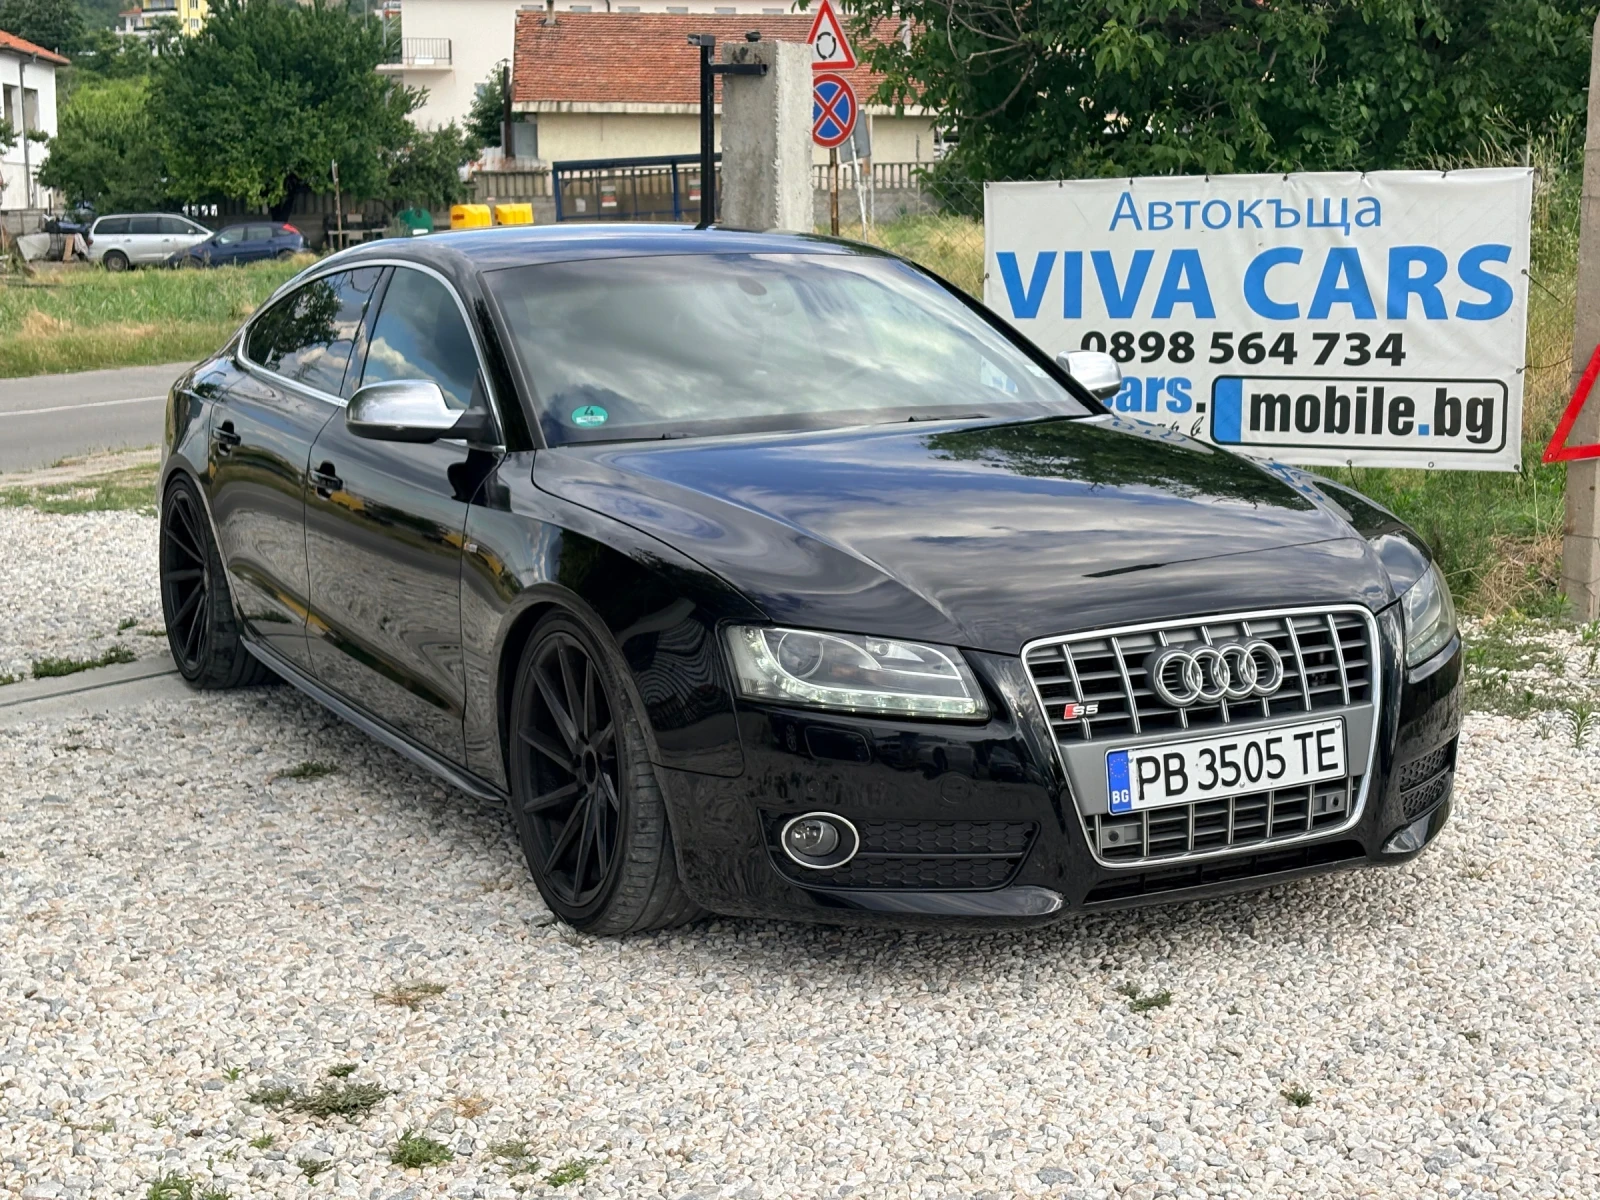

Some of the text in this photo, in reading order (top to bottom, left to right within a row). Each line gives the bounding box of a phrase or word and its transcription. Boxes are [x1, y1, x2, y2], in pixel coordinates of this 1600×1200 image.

[1109, 191, 1382, 236] Автокъща
[996, 243, 1514, 321] VIVA CARS
[1081, 330, 1406, 366] 0898 564 734
[1102, 376, 1206, 414] ars.
[1250, 386, 1494, 444] mobile.bg
[1072, 704, 1098, 716] S5
[1135, 728, 1339, 801] PB 3505 TE
[1112, 790, 1130, 804] BG
